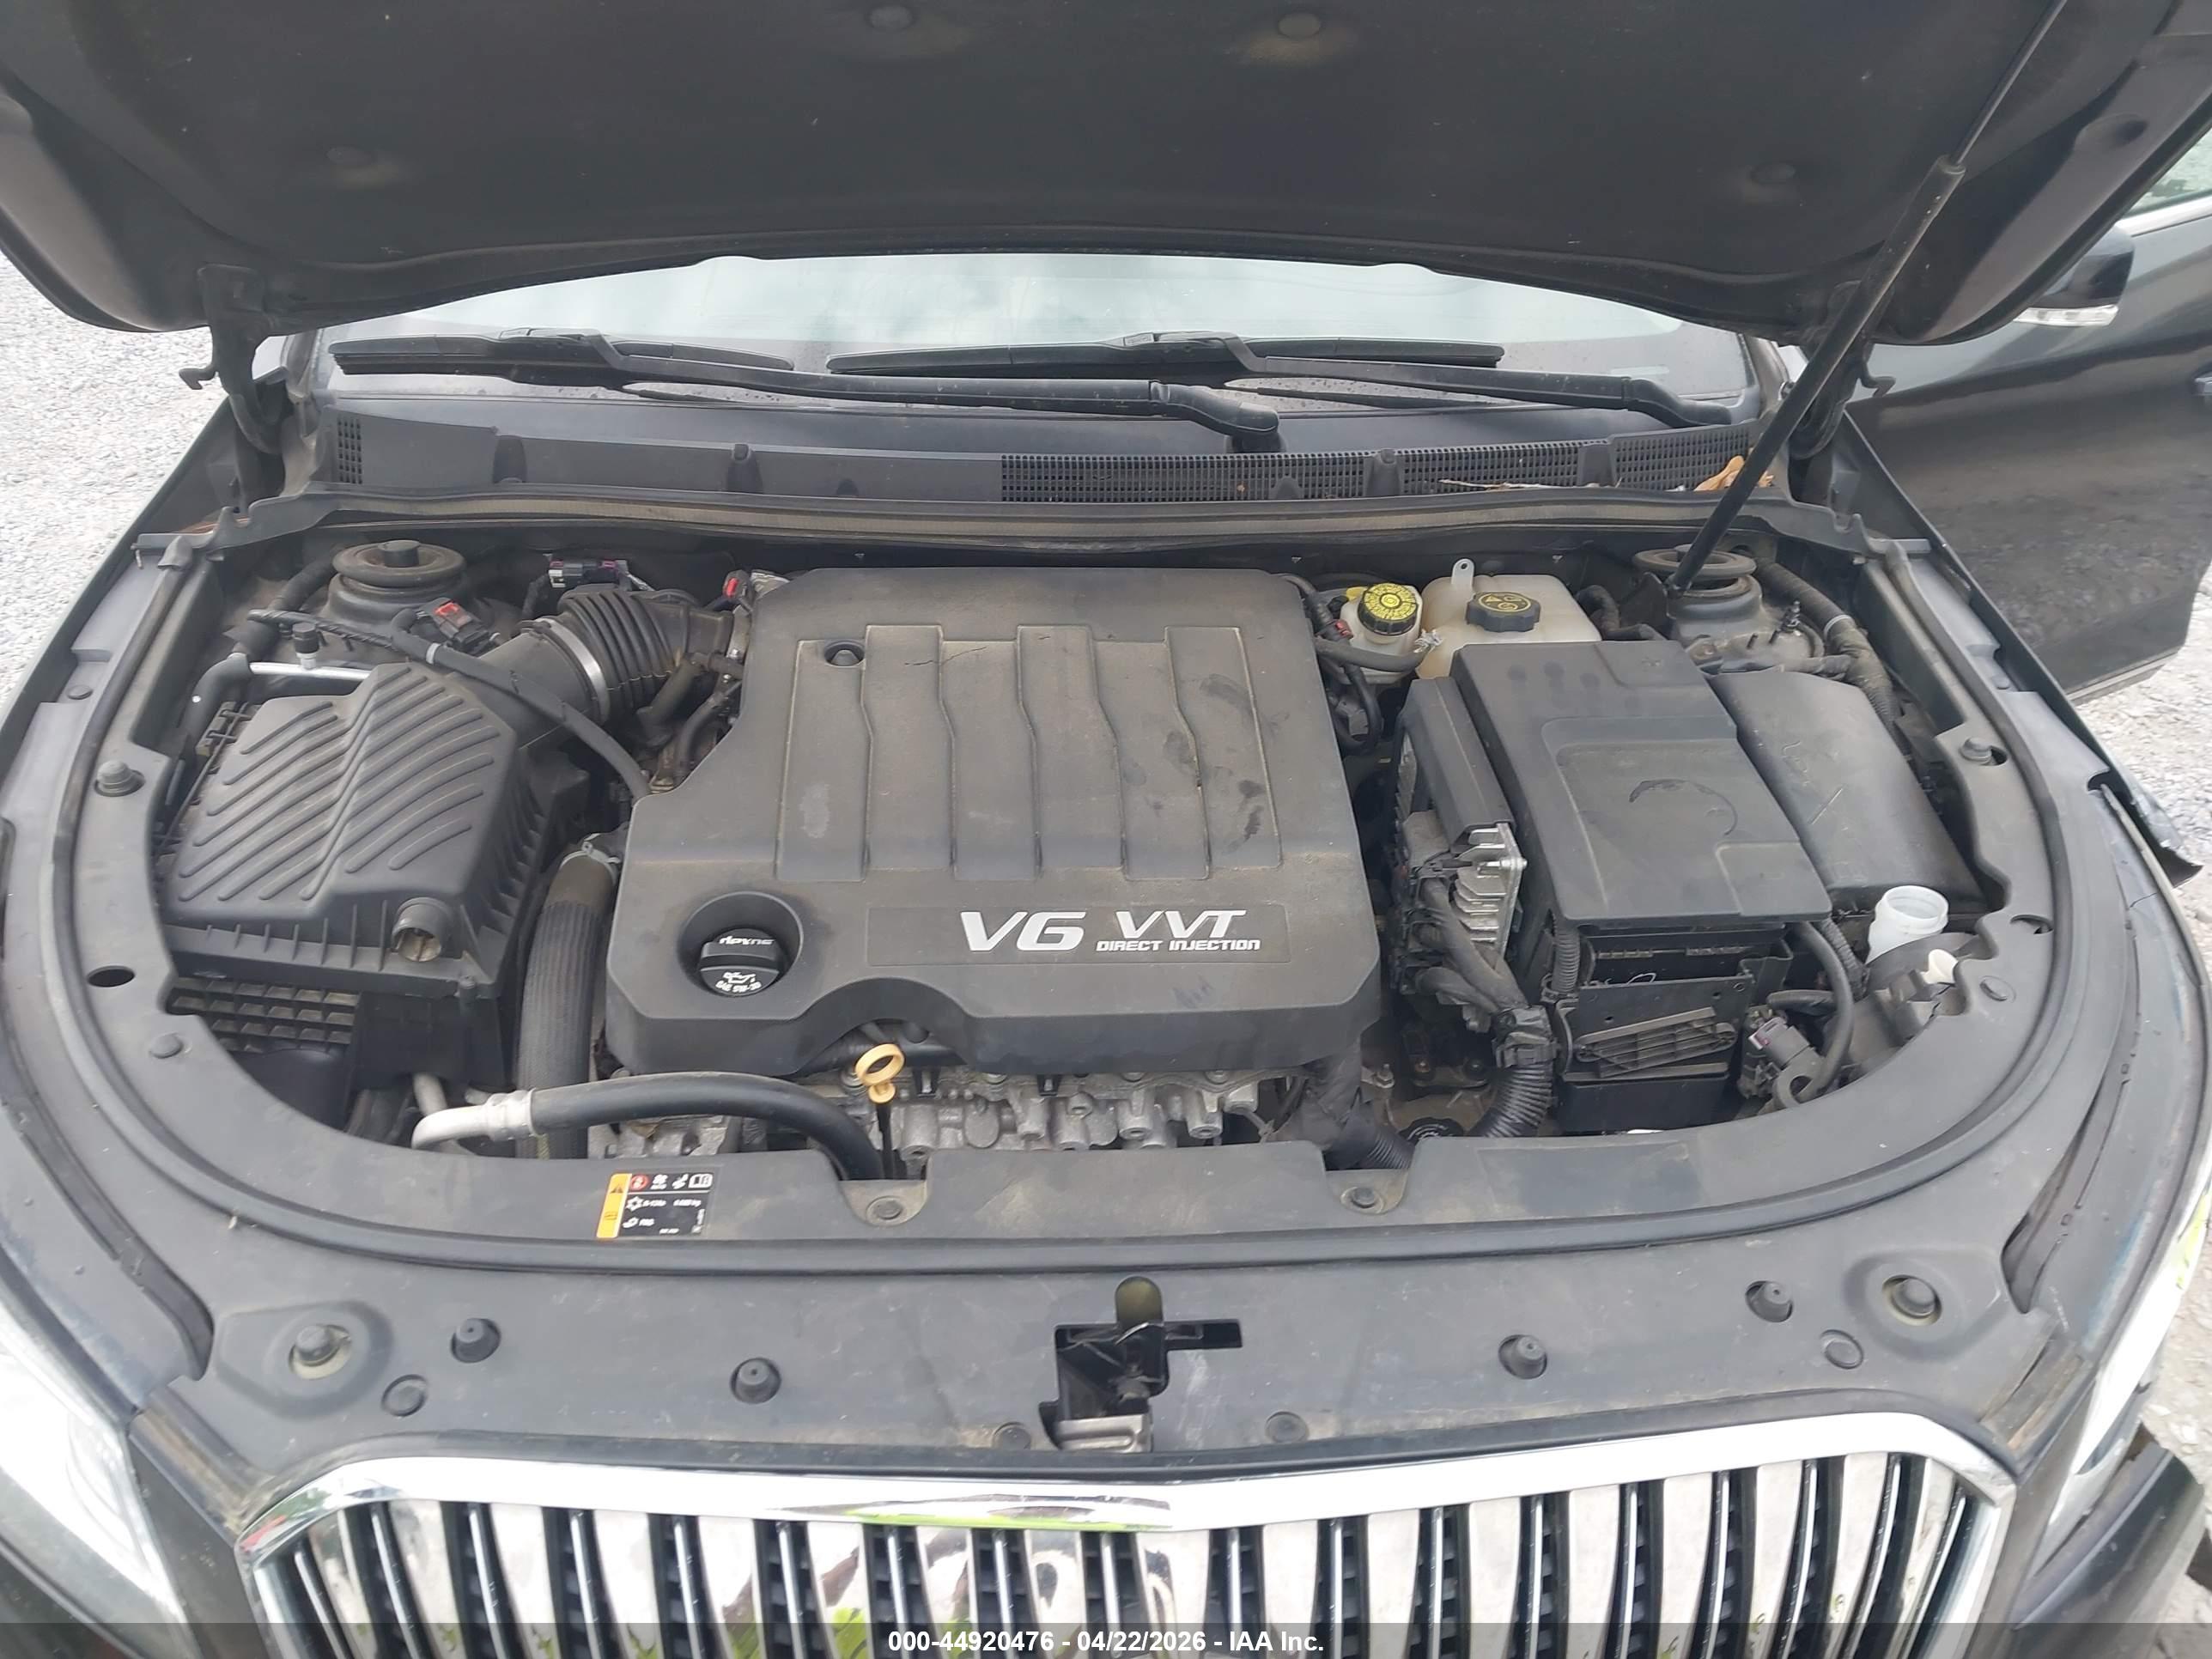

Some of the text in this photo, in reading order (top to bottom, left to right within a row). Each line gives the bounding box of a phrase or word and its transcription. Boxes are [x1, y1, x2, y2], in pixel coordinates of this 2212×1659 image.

[961, 910, 1247, 951] V6 VVT
[1096, 939, 1261, 951] DIRECT INJECTION
